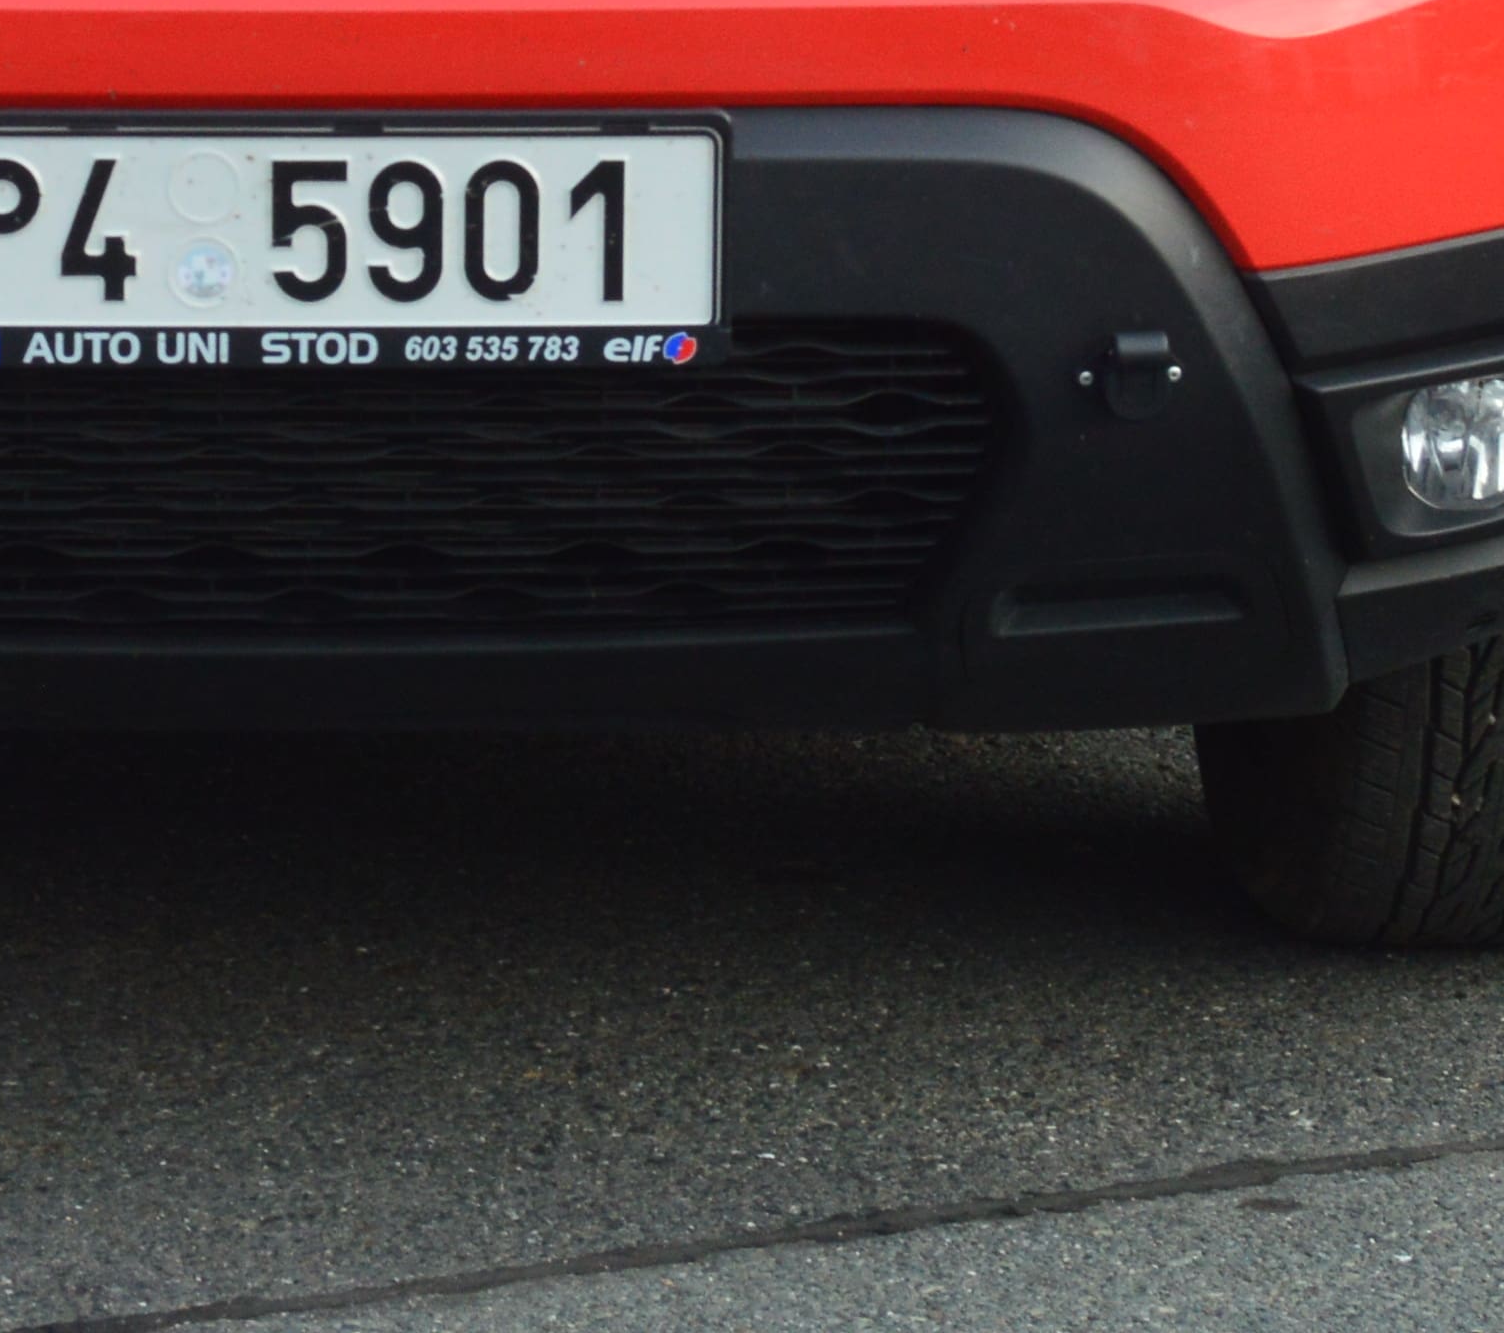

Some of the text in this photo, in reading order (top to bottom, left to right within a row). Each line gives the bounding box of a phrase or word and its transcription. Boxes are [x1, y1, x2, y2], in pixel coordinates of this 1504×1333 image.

[270, 159, 626, 303] 5901
[22, 331, 141, 364] AUTO
[157, 331, 230, 364] UNI
[260, 331, 379, 364] STOD
[404, 335, 458, 361] 603
[464, 335, 520, 361] 535
[526, 335, 581, 361] 783
[603, 334, 664, 363] elf
